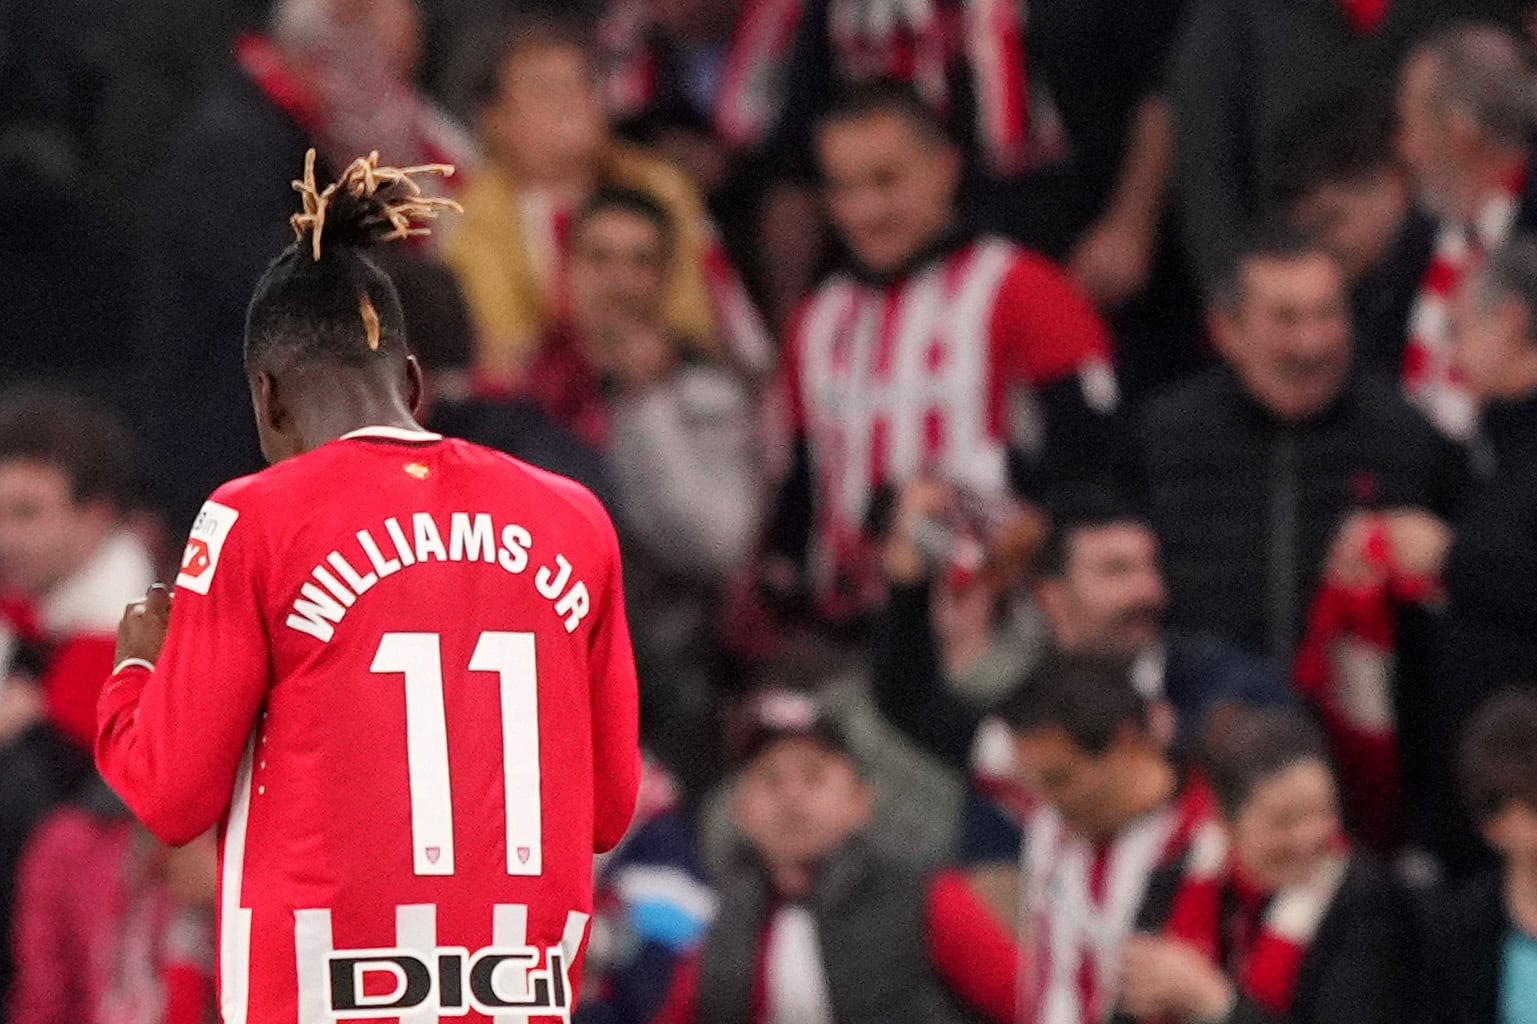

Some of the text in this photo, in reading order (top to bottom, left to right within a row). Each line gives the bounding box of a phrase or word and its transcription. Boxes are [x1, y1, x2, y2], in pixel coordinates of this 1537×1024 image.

[286, 511, 590, 643] WILLIAMS JR
[369, 631, 543, 877] 11
[328, 953, 566, 1011] DIGI
